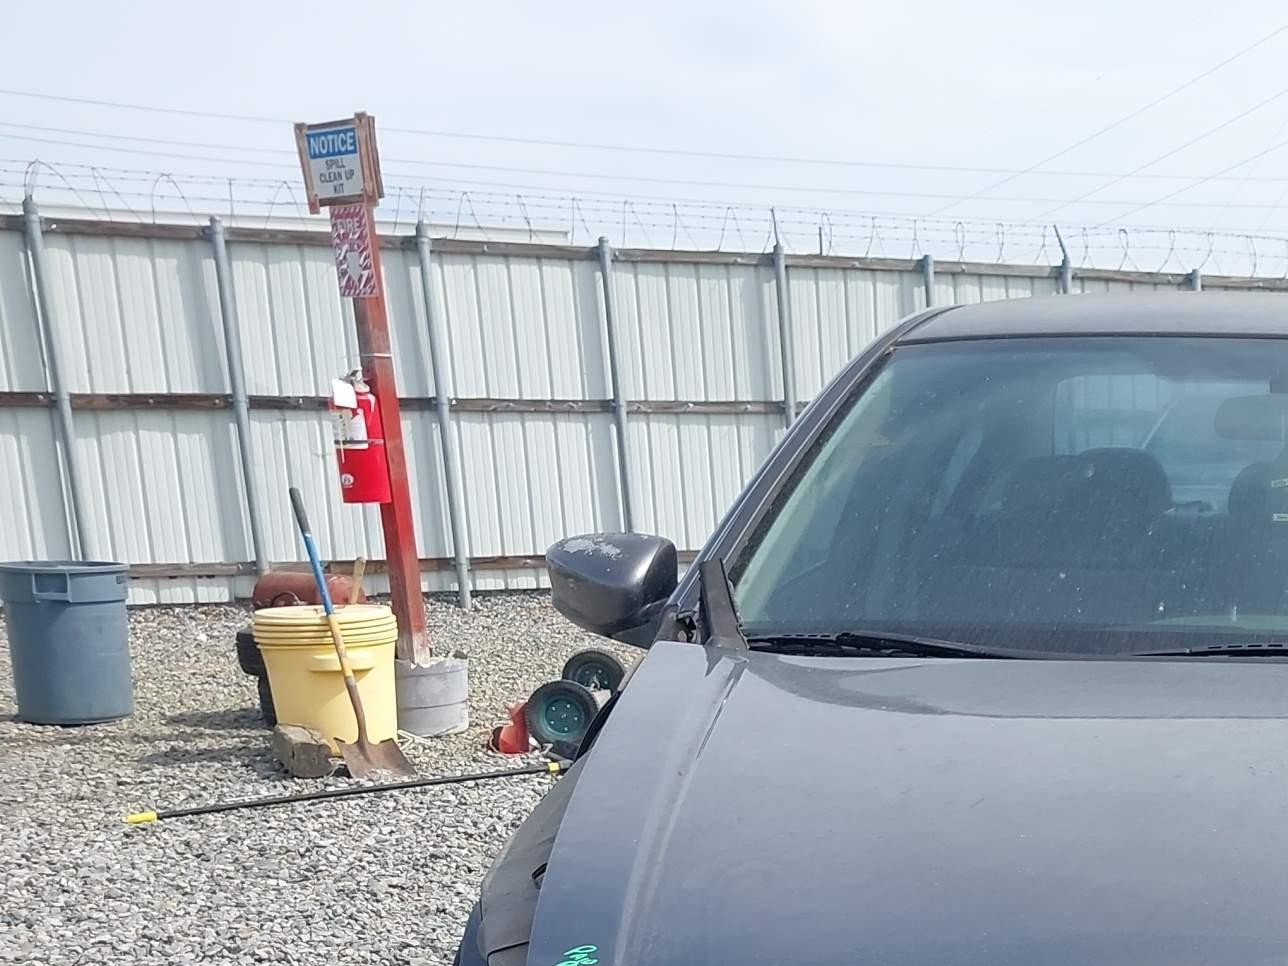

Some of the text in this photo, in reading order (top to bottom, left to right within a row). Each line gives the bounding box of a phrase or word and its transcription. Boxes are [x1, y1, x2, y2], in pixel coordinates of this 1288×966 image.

[310, 132, 355, 156] NOTICE
[325, 159, 346, 170] SPILL
[319, 169, 355, 184] CLEAN UP
[333, 183, 345, 194] KIT
